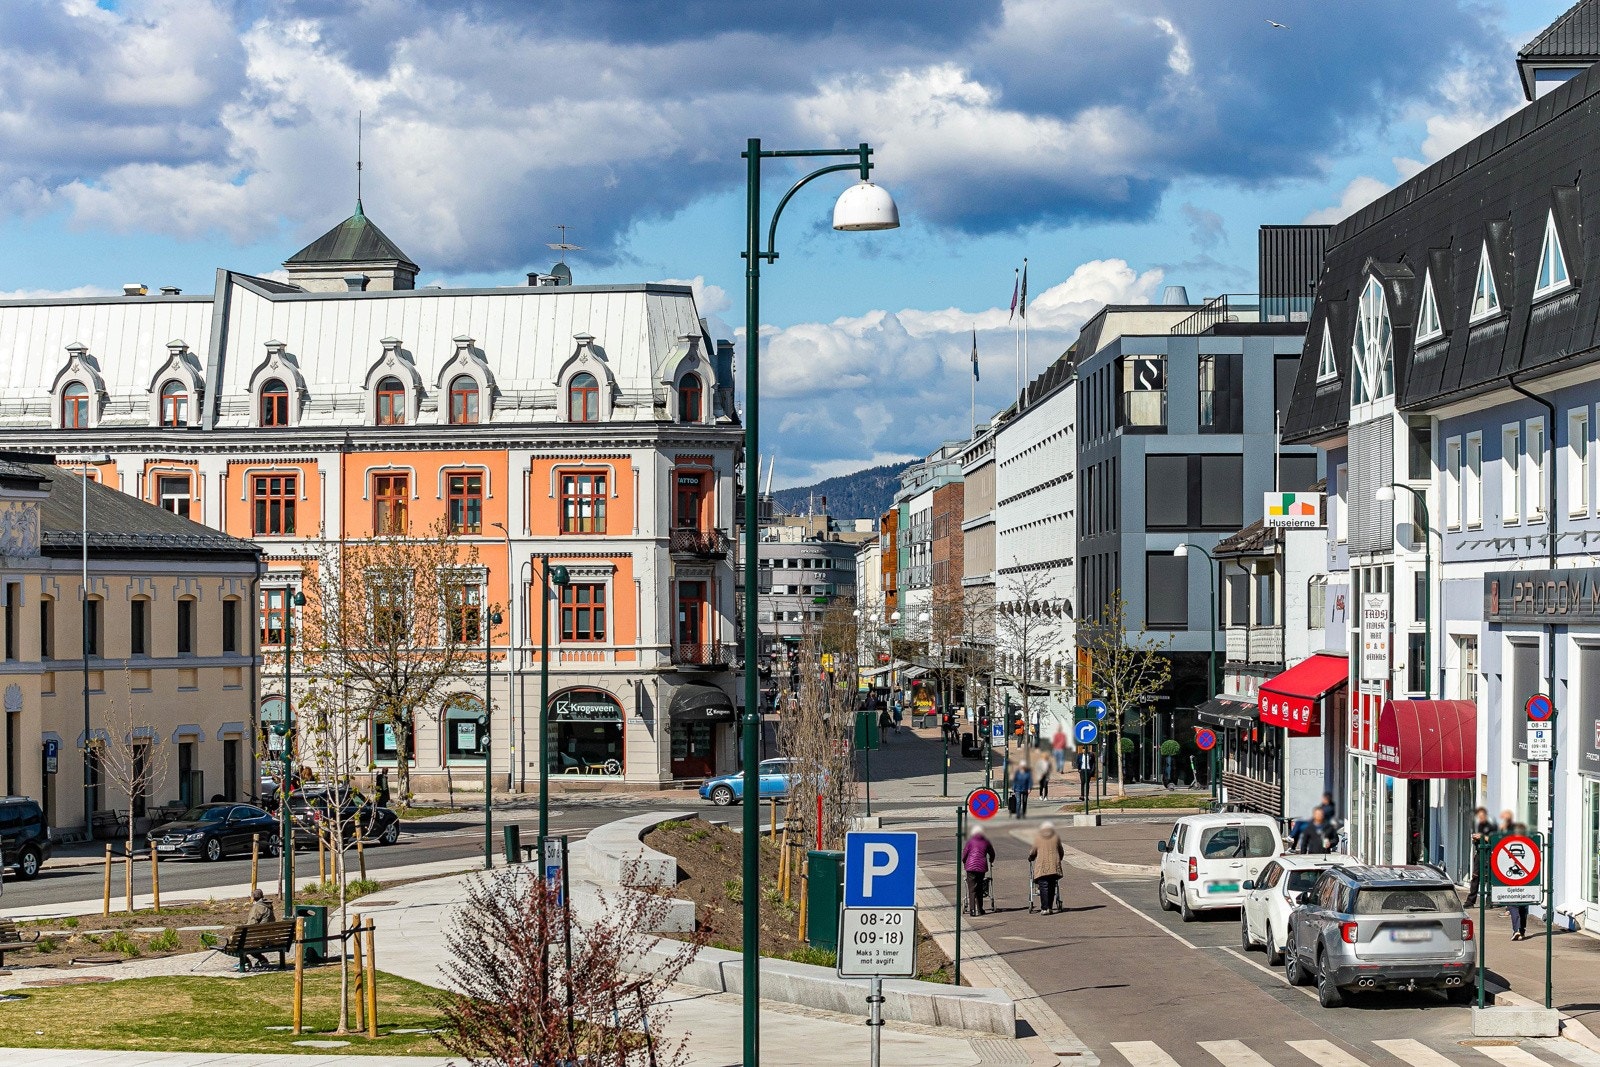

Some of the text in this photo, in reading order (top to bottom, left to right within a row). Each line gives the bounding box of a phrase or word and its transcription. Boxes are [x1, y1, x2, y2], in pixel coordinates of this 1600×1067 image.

[1269, 518, 1315, 527] Huseierne
[1513, 580, 1580, 615] PROCOM
[570, 703, 614, 714] Krogsveen
[49, 743, 55, 756] P
[862, 843, 899, 897] P
[876, 958, 894, 966] avgift
